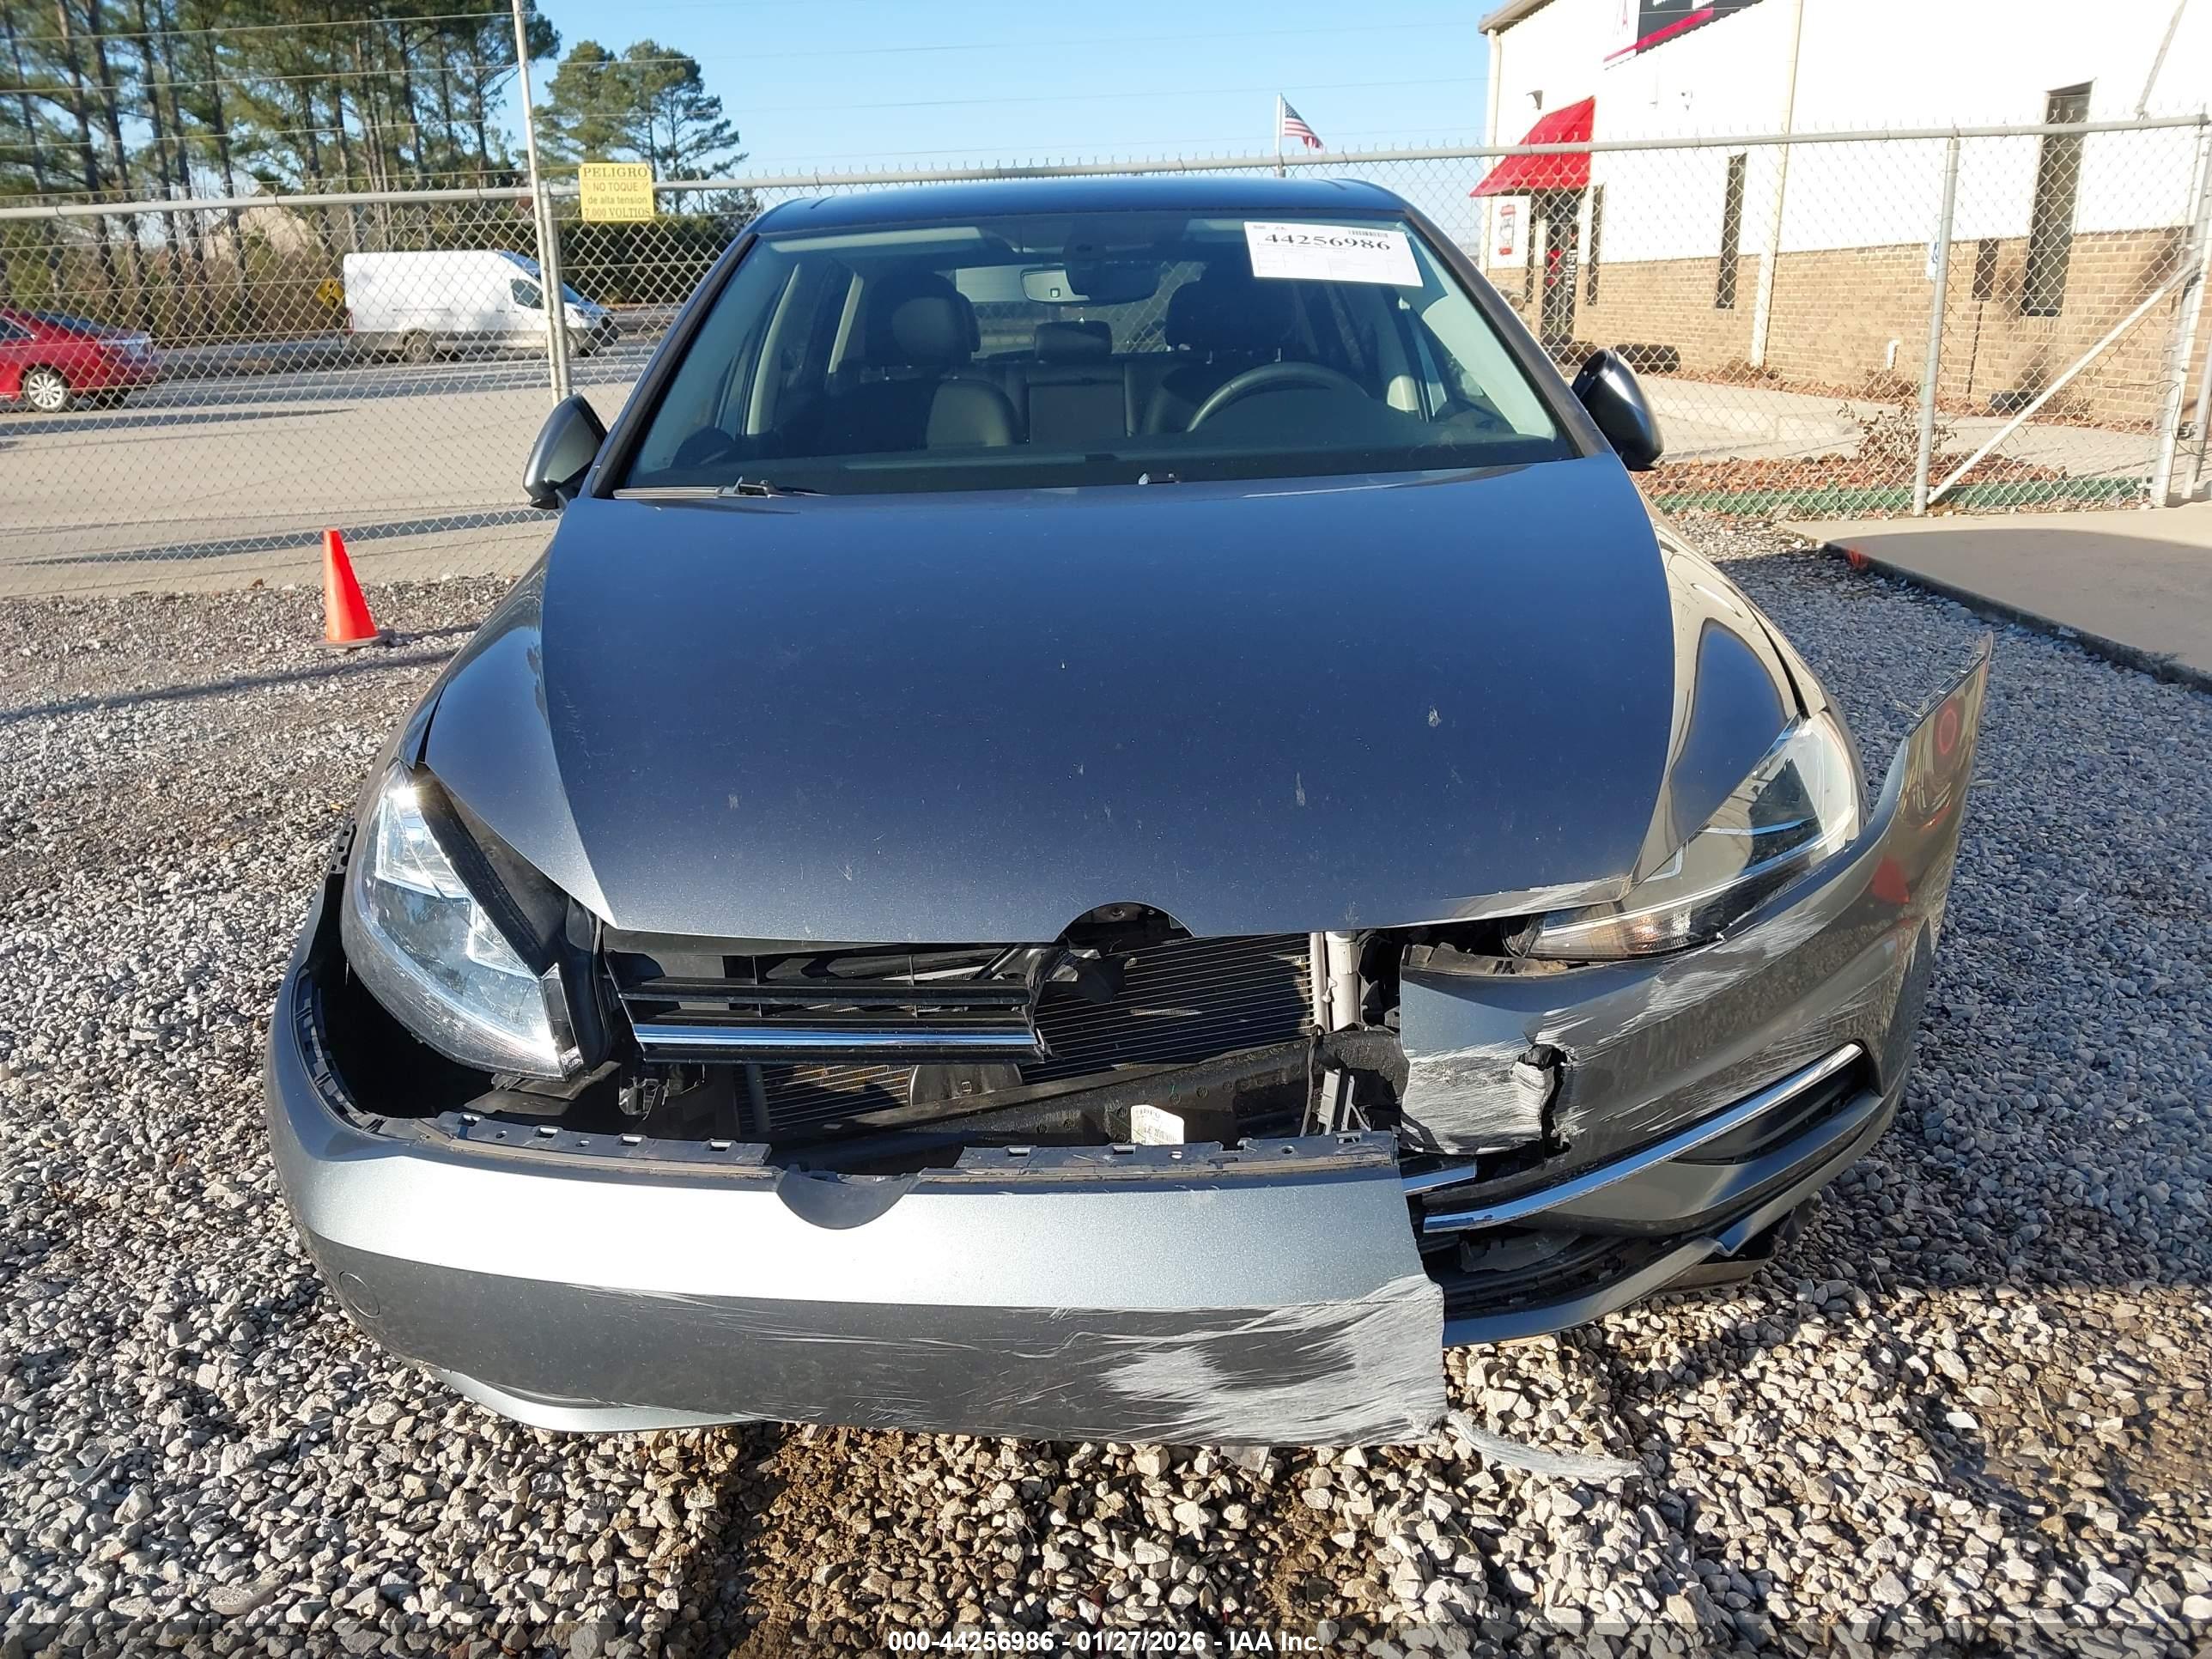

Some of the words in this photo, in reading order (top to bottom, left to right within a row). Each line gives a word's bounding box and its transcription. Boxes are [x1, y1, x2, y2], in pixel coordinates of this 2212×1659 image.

[583, 167, 648, 178] PELIGRO
[592, 182, 606, 191] NO
[609, 182, 639, 192] TOQUE
[587, 196, 599, 204] de
[600, 195, 616, 204] alta
[609, 207, 652, 218] VOLTIOS
[1265, 234, 1391, 251] 44256986
